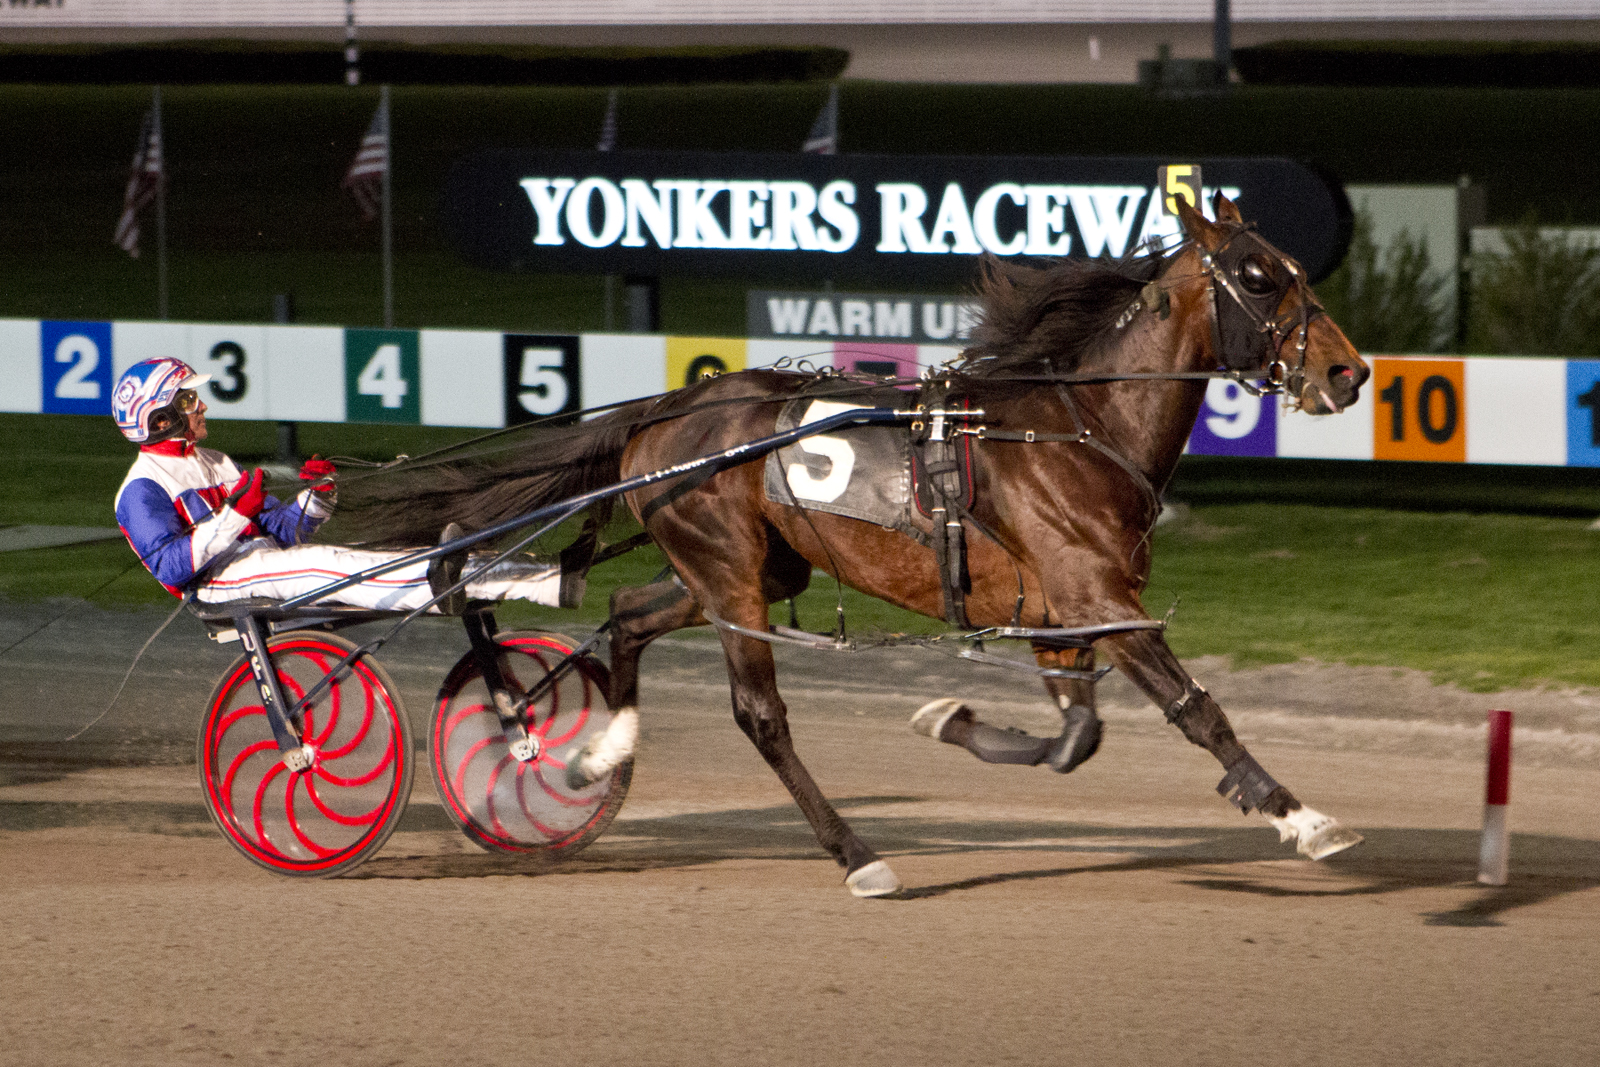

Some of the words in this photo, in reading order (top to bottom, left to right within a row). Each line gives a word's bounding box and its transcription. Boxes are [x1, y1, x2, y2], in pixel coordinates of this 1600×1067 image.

[519, 177, 860, 253] YONKERS
[1166, 164, 1196, 215] 5
[766, 297, 913, 338] WARM
[55, 336, 100, 400] 2
[208, 340, 248, 403] 3
[357, 344, 407, 409] 4
[518, 347, 568, 416] 5
[1204, 377, 1261, 440] 9
[1379, 374, 1459, 445] 10
[786, 399, 876, 504] 5
